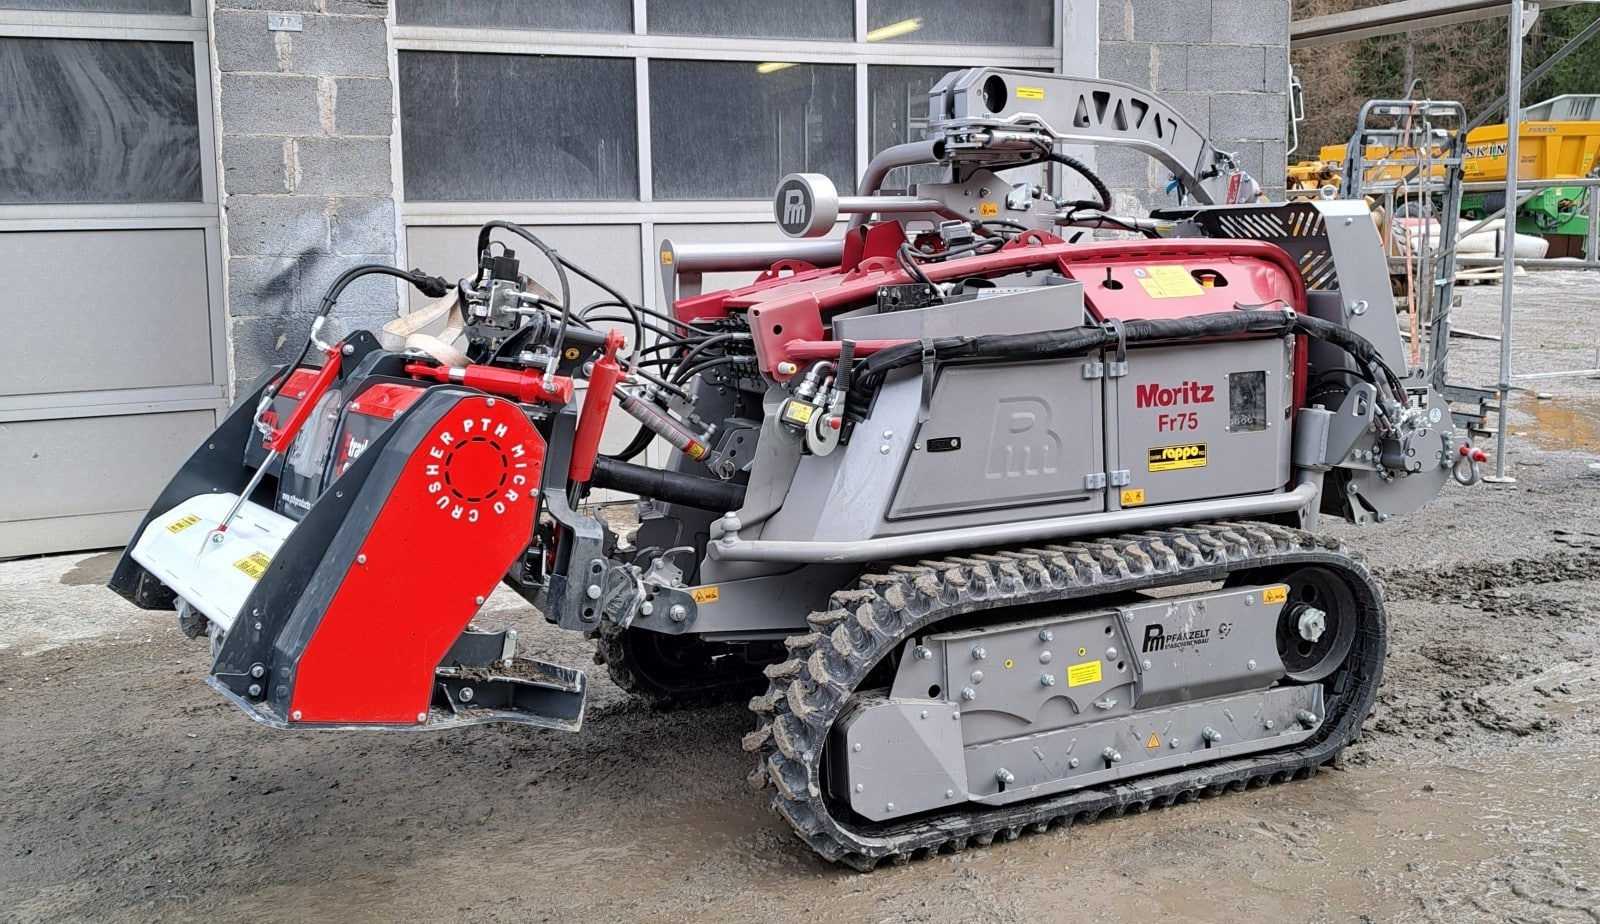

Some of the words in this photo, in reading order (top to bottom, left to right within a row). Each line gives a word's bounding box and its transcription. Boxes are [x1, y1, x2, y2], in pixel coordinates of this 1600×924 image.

[1136, 381, 1215, 409] Moritz
[462, 418, 509, 438] PTH
[1158, 412, 1199, 433] Fr75
[1162, 446, 1199, 461] rappo
[425, 431, 480, 523] CRUSHER
[493, 443, 528, 515] MICRO
